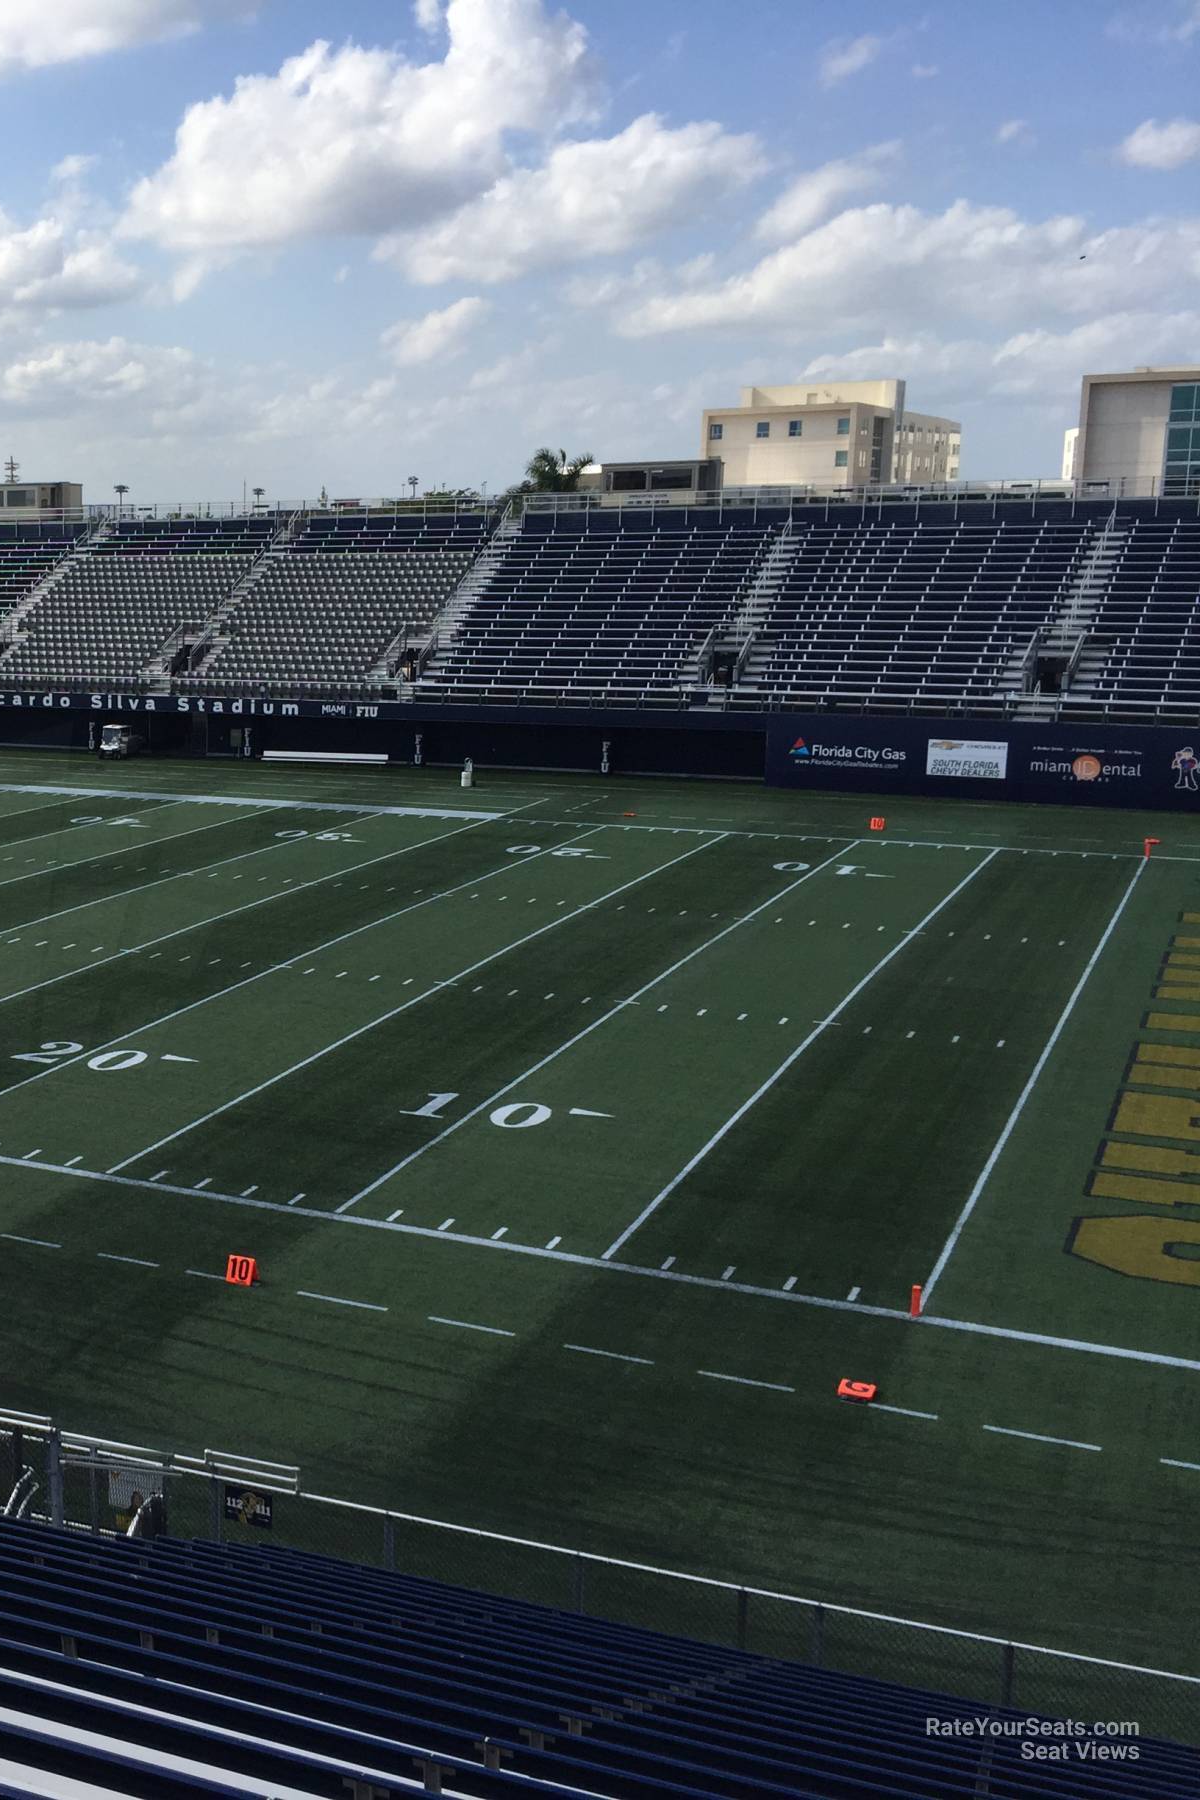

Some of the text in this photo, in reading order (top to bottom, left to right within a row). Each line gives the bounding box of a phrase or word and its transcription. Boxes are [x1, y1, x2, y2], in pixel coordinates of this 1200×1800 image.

[91, 694, 156, 711] Silva
[177, 697, 299, 716] Stadium
[321, 704, 379, 718] MIAMI FIU
[414, 734, 423, 765] FIU
[601, 741, 611, 773] FIU
[811, 744, 907, 761] Florida City Gas
[930, 766, 1000, 778] CHEVY DEALERS
[932, 759, 999, 769] SOUTH FLORIDA
[10, 1041, 148, 1071] 20
[399, 1092, 553, 1129] 10
[230, 1257, 250, 1281] 10
[226, 1496, 244, 1510] 112
